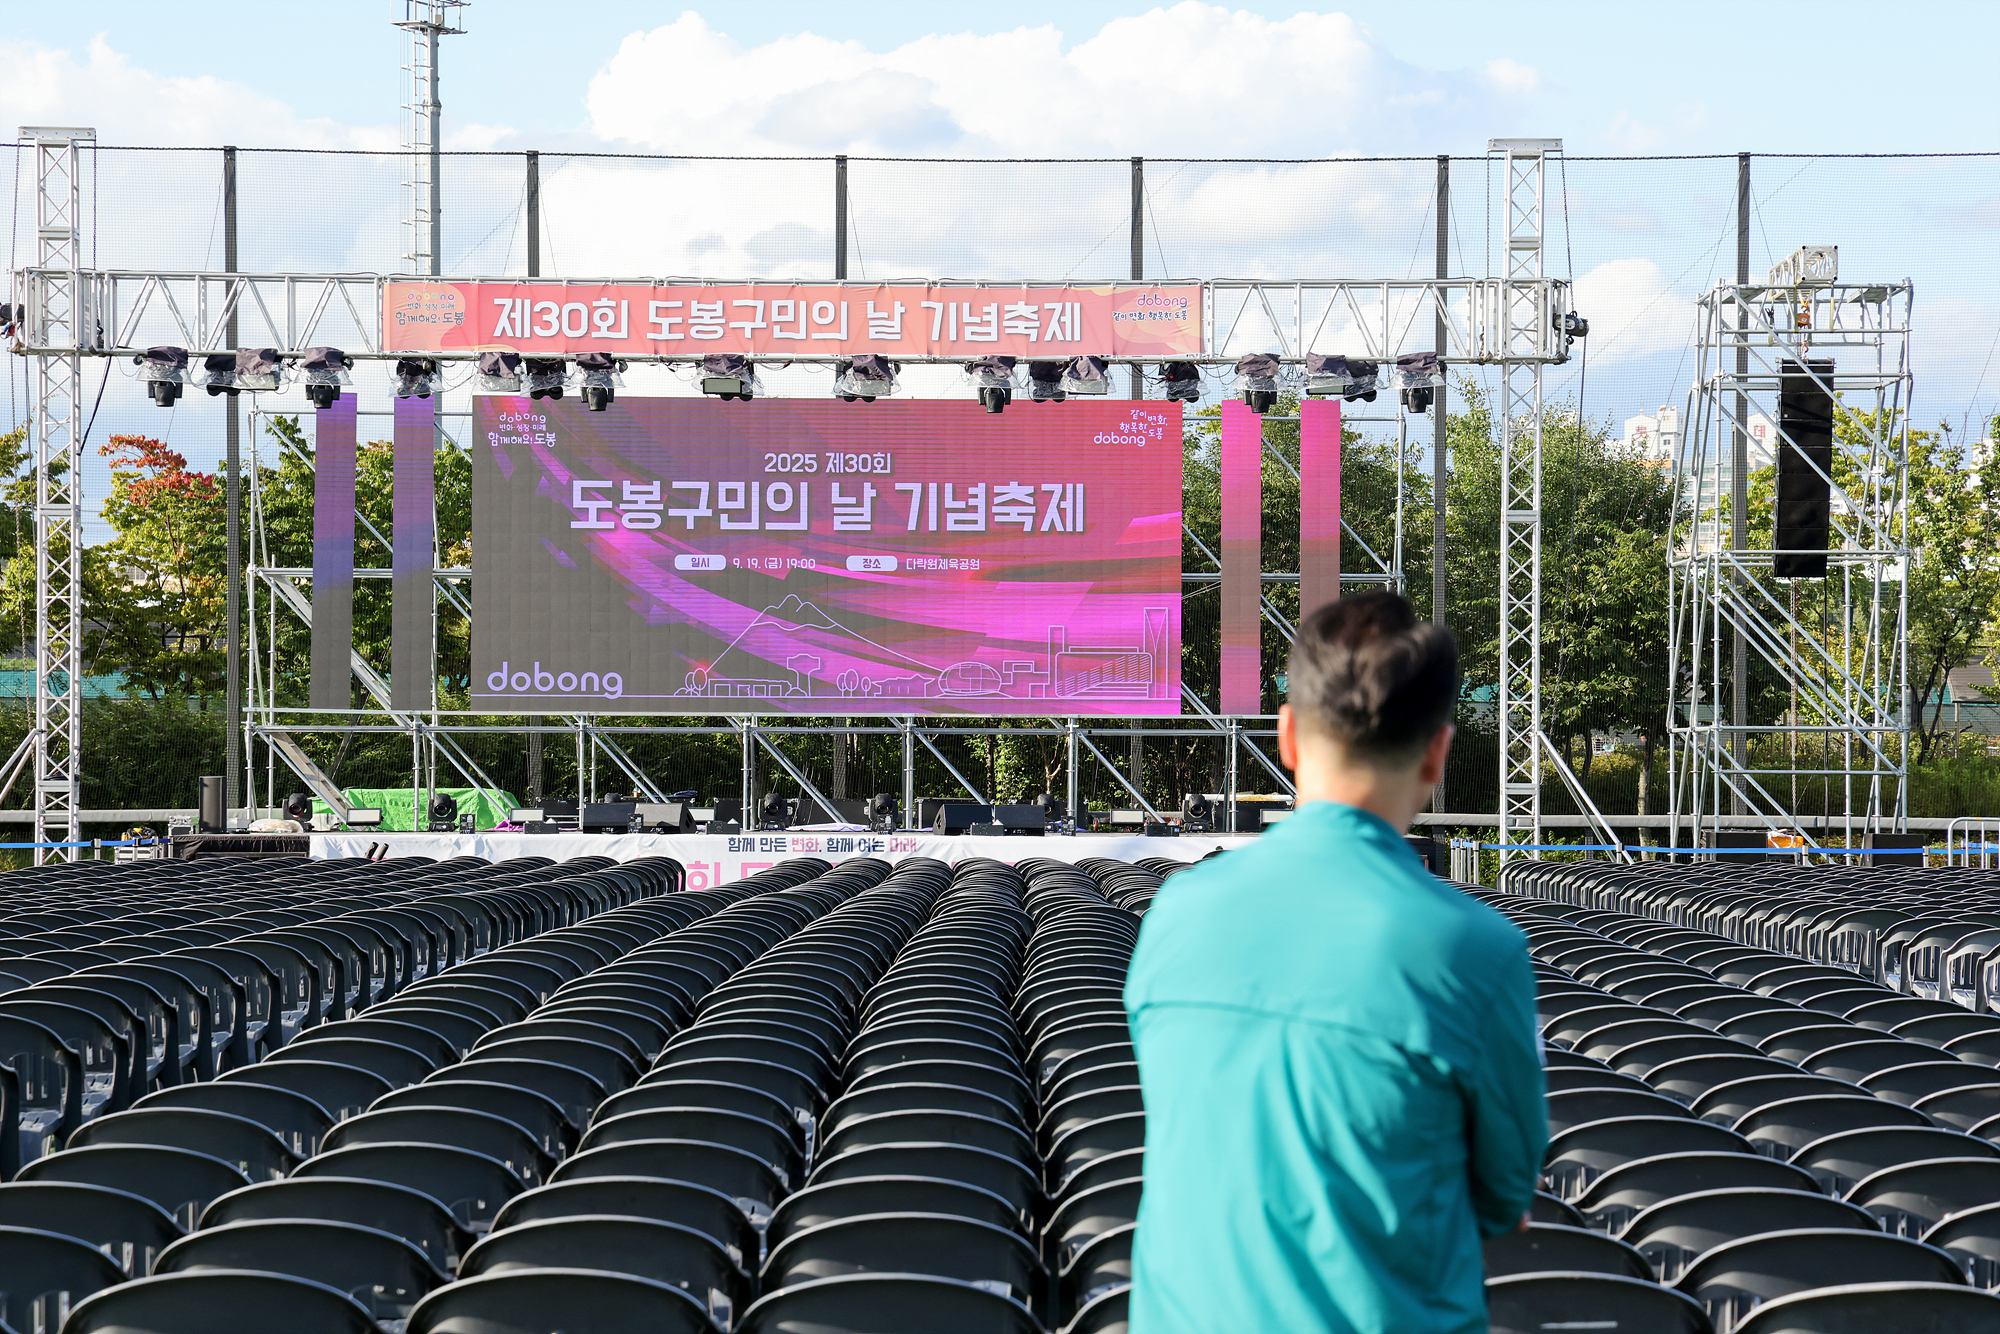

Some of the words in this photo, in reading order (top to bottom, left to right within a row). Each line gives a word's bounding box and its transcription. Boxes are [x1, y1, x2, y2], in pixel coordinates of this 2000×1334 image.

[1137, 293, 1188, 308] dobong
[442, 311, 465, 326] 도봉
[493, 297, 629, 339] 제30회
[646, 299, 848, 340] 도봉구민의
[867, 300, 906, 340] 날
[920, 301, 1081, 342] 기념축제
[1112, 311, 1127, 322] 같이
[1148, 310, 1173, 321] 행복한
[1174, 310, 1187, 321] 도봉
[499, 412, 546, 424] dobong
[1130, 409, 1147, 420] 같이
[1119, 421, 1148, 434] 행복한
[1148, 427, 1163, 440] 도봉
[534, 432, 556, 447] 도봉
[1093, 431, 1146, 447] dobong
[764, 453, 818, 473] 2025
[825, 452, 891, 474] 제30회
[570, 480, 809, 531] 도봉구민의
[831, 481, 877, 531] 날
[894, 481, 1085, 532] 기념축제
[690, 557, 710, 568] 일시
[732, 557, 743, 569] 9.
[746, 557, 761, 569] 19.
[764, 557, 782, 569] (금)
[786, 558, 816, 569] 19:00
[862, 558, 882, 569] 장소
[906, 558, 980, 570] 다락원체육공원
[487, 661, 623, 700] dobong
[728, 837, 755, 852] 함께
[760, 837, 787, 852] 만든
[826, 837, 853, 852] 함께
[858, 837, 885, 852] 여는
[890, 837, 917, 852] 미래
